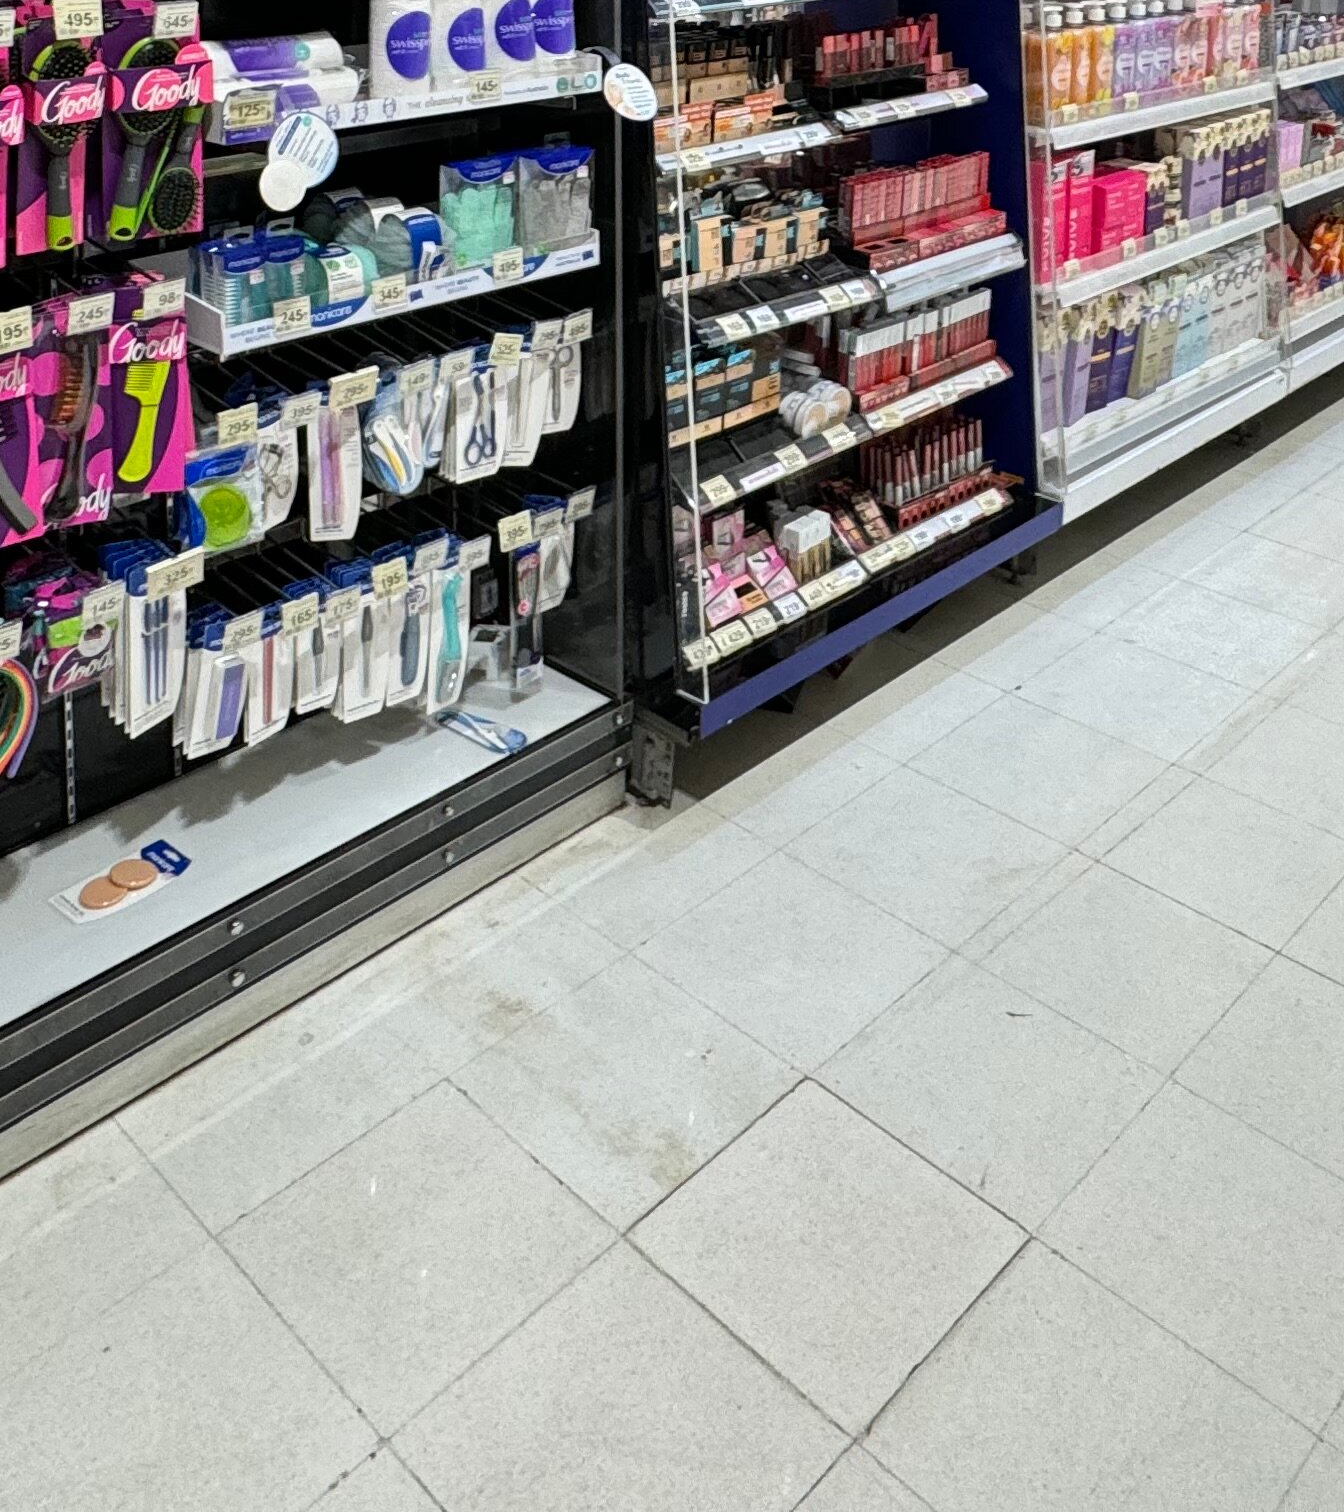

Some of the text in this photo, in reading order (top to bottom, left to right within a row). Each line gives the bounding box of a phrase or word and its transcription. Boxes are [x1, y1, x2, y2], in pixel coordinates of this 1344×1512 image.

[41, 75, 107, 124] Goody
[132, 64, 201, 111] Goody
[108, 322, 185, 363] Goody
